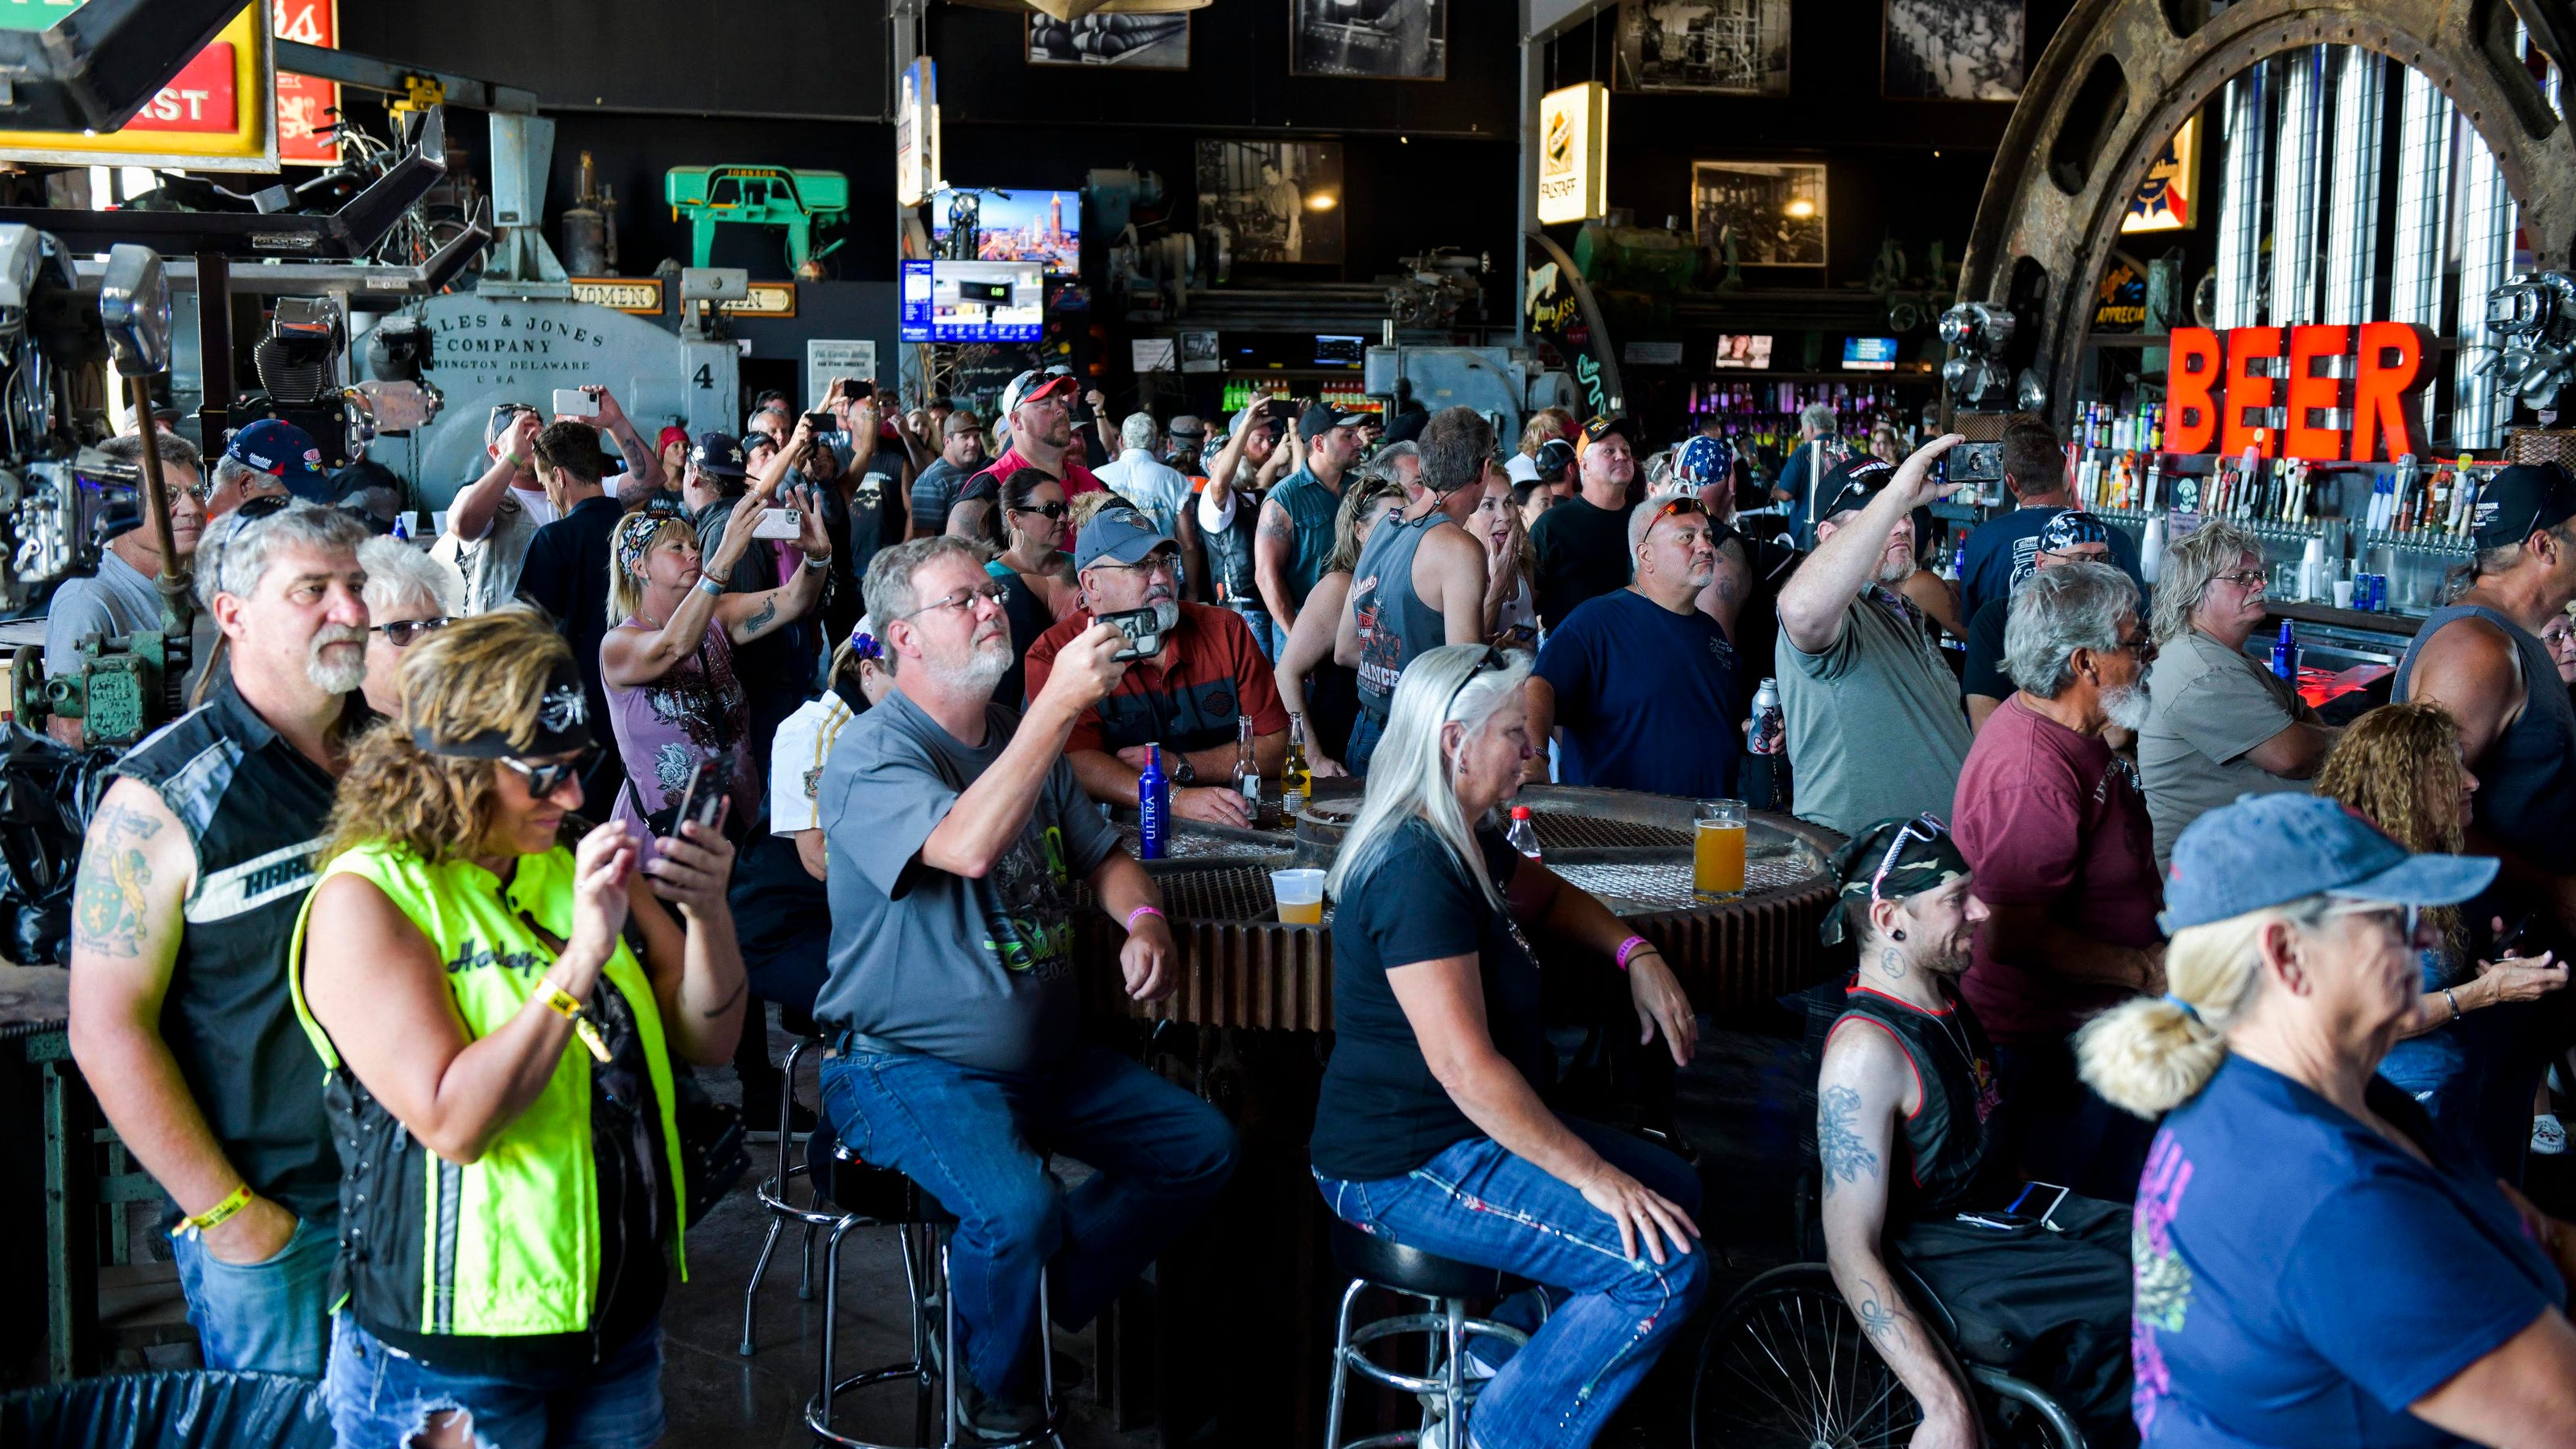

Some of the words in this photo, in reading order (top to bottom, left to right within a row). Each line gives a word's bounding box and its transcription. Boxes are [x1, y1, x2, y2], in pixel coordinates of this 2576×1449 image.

[728, 168, 777, 177] JOHNSON
[726, 291, 762, 308] EN
[501, 315, 512, 327] &
[526, 316, 604, 347] JONES
[447, 338, 551, 354] COMPANY
[509, 360, 591, 371] DELAWARE
[691, 362, 715, 390] 4
[2164, 320, 2421, 464] BEER
[1146, 795, 1155, 840] ULTRA
